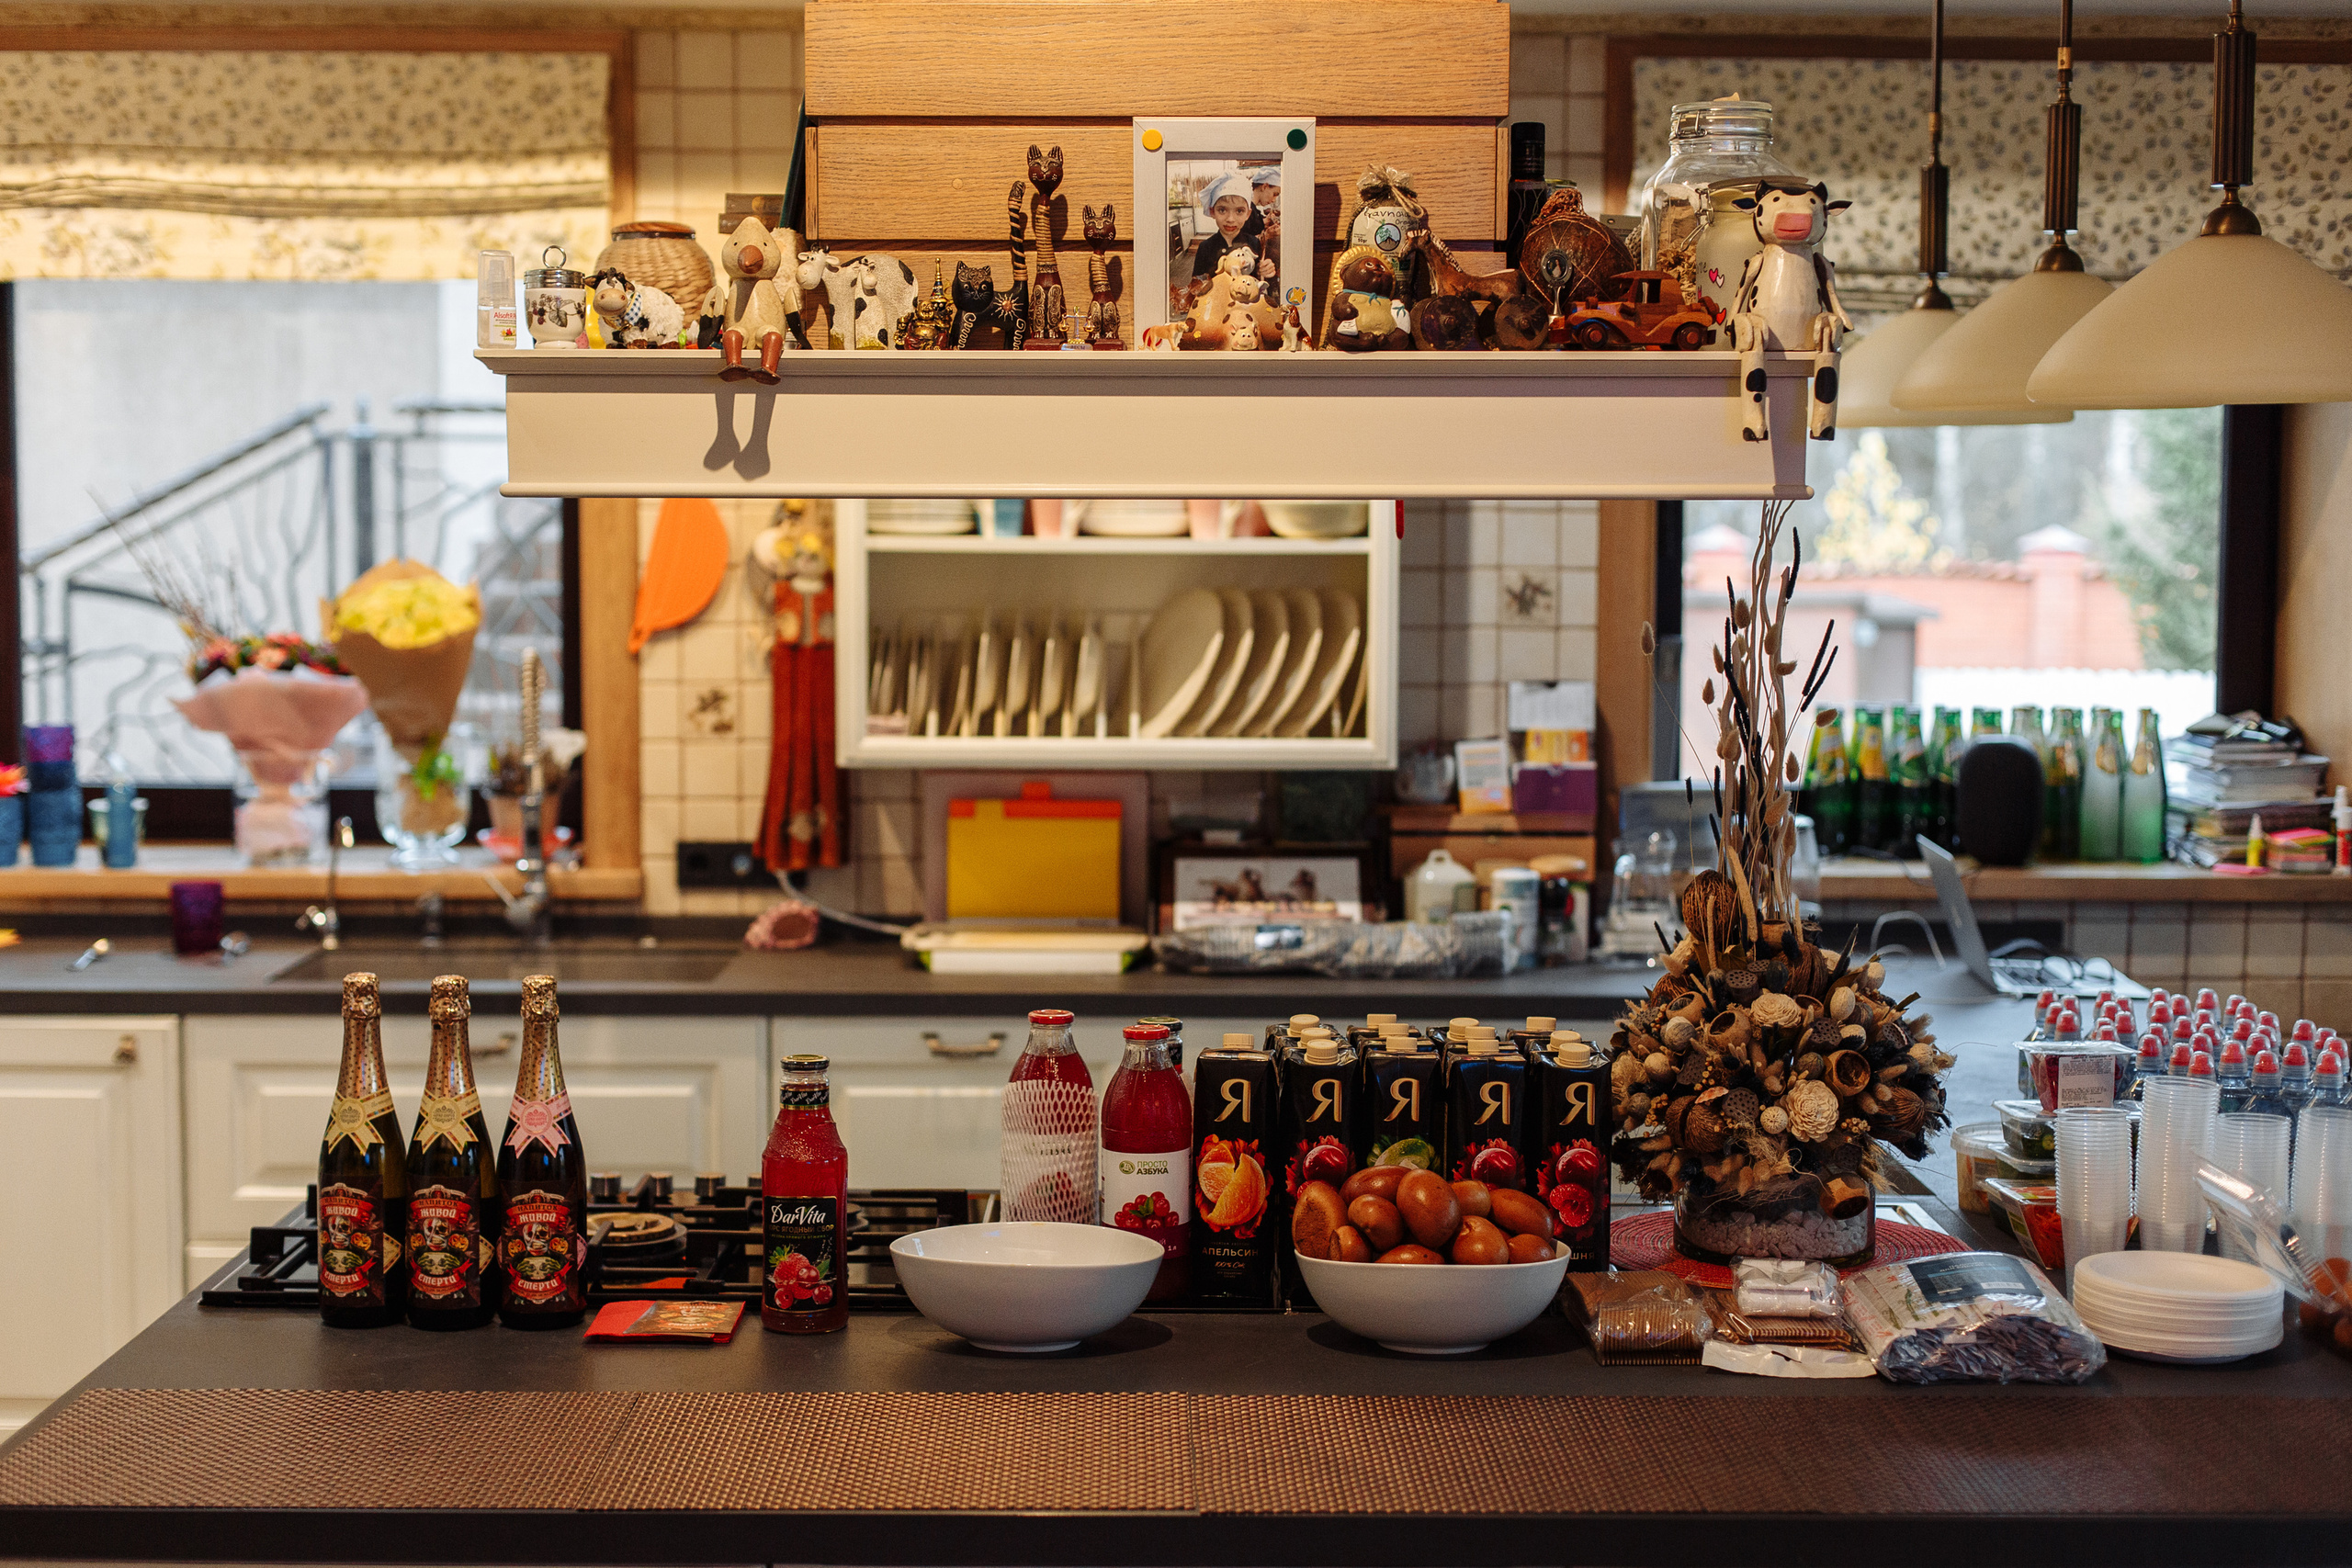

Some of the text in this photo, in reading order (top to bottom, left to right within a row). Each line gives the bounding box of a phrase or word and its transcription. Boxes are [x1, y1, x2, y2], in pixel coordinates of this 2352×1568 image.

[1214, 1077, 1250, 1122] Я
[1306, 1077, 1342, 1122] Я
[1384, 1077, 1419, 1122] Я
[1474, 1080, 1510, 1125] Я
[1559, 1081, 1595, 1126] Я
[324, 1197, 359, 1206] НАПИТОК
[418, 1199, 458, 1208] НАПИТОК
[517, 1203, 559, 1212] НАПИТОК
[771, 1203, 826, 1225] DarVita
[781, 1224, 815, 1234] ЯГОДНЫЙ
[816, 1224, 834, 1232] СБОР
[1202, 1247, 1259, 1258] АПЕЛЬСИН
[1569, 1252, 1595, 1260] ШНЯ
